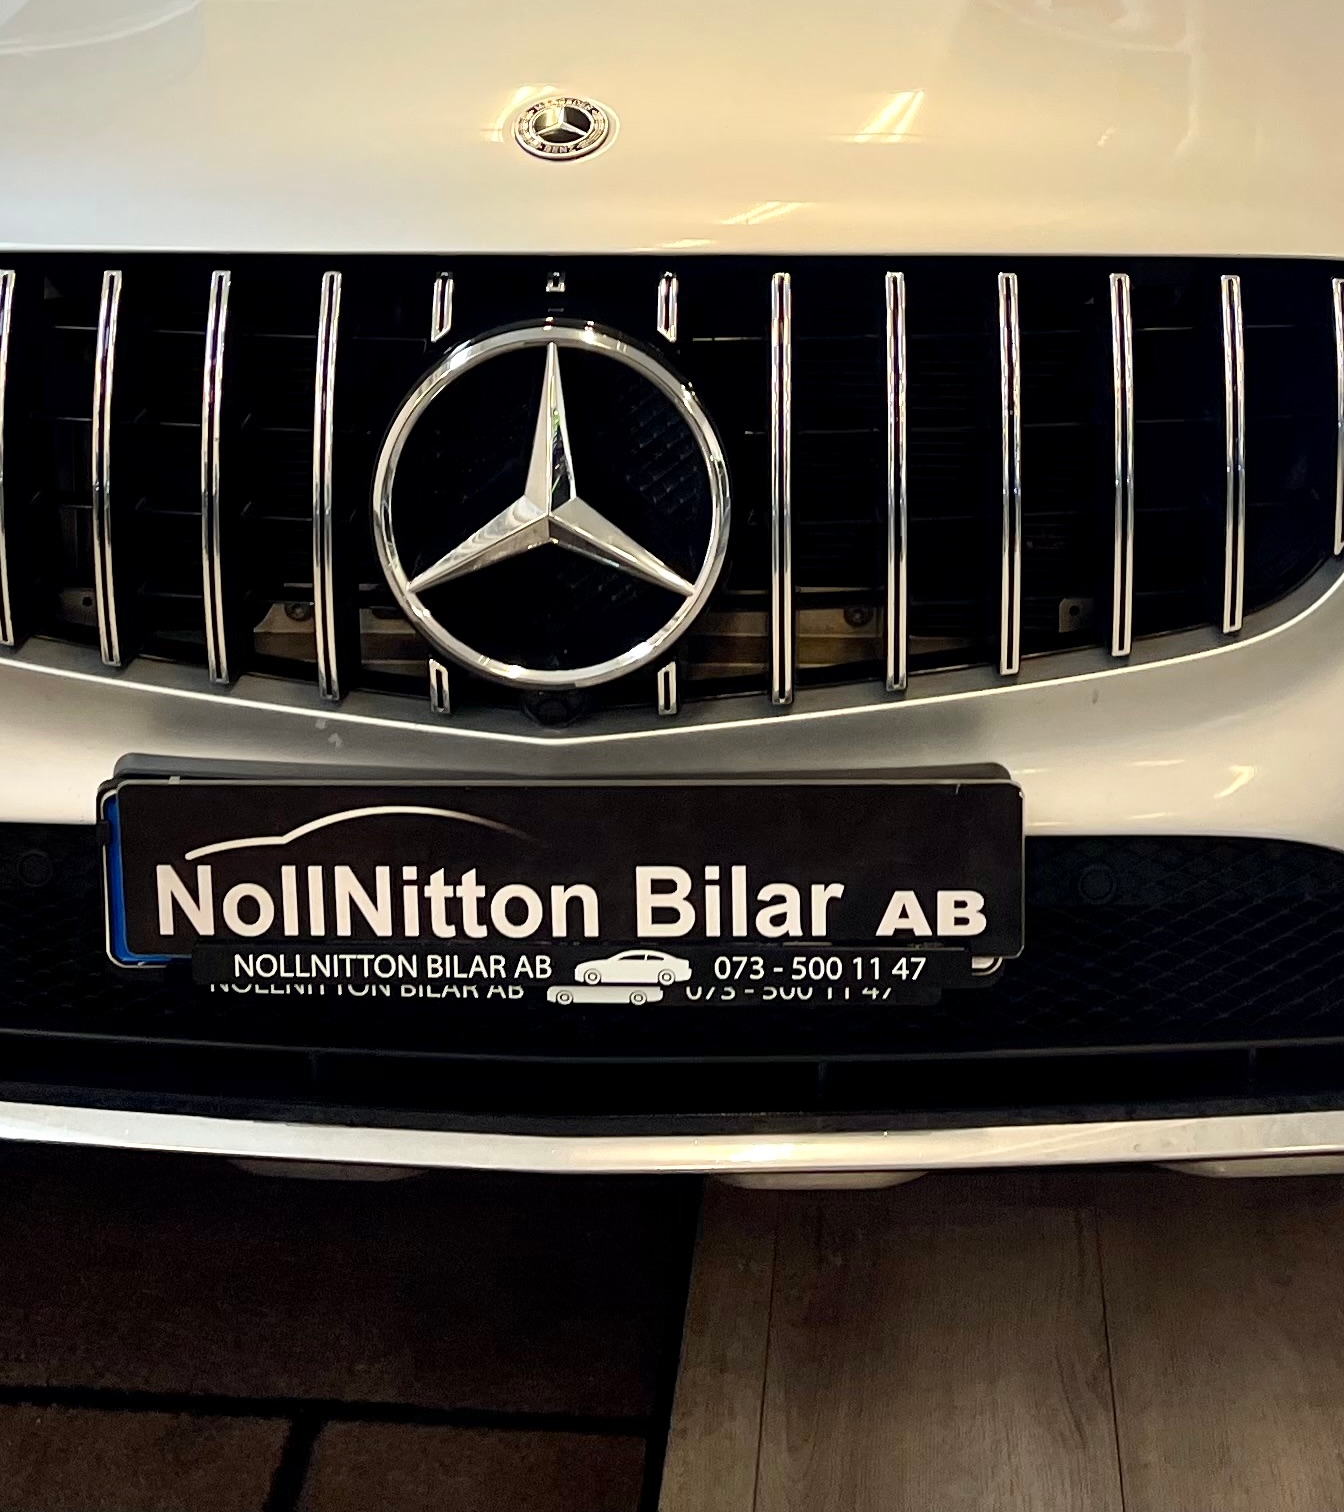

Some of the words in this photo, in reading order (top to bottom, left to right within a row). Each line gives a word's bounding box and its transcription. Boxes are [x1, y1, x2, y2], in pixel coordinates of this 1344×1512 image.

[156, 864, 599, 939] NollNitton
[635, 864, 845, 938] Bilar
[875, 889, 987, 937] AB
[233, 953, 418, 979] NOLLNITTON
[426, 954, 507, 979] BILAR
[514, 954, 553, 979] AB
[714, 956, 765, 980] 073
[791, 956, 843, 980] 500
[853, 957, 880, 980] 11
[891, 957, 927, 980] 47
